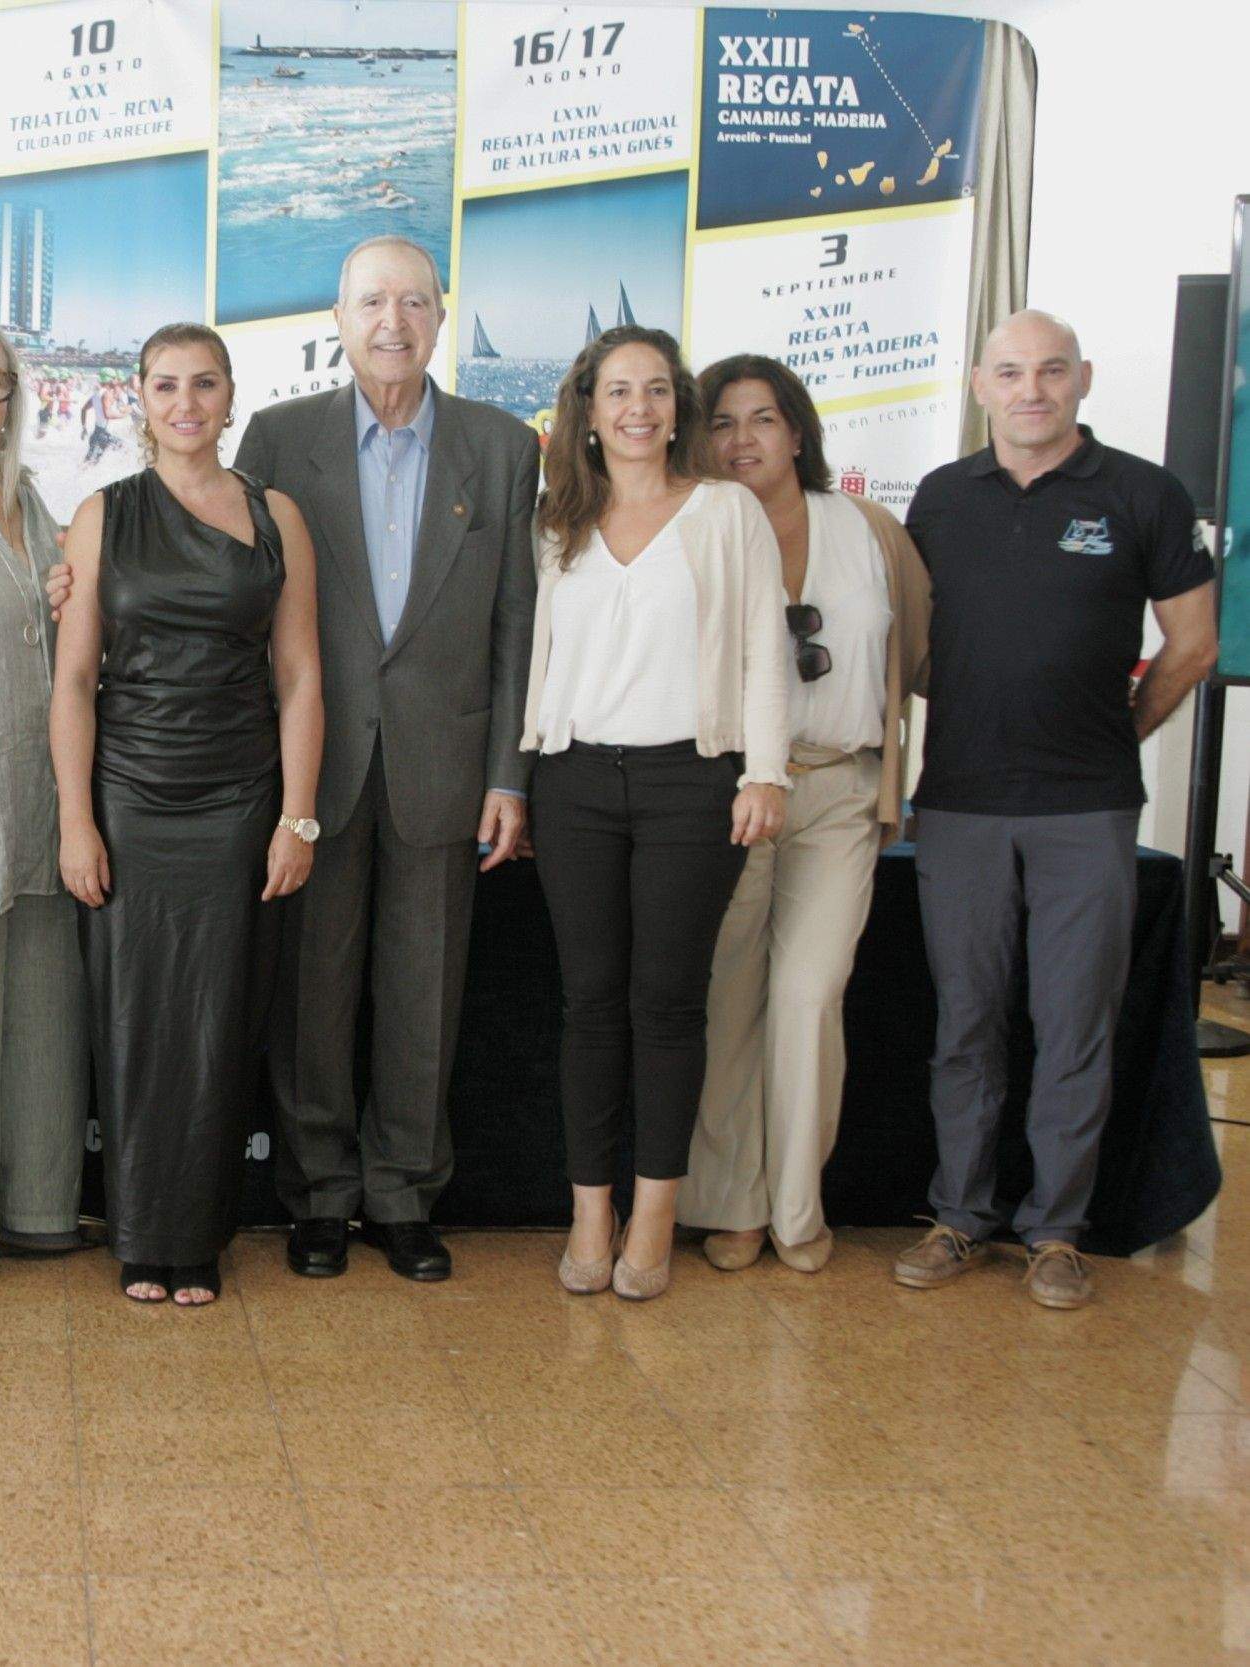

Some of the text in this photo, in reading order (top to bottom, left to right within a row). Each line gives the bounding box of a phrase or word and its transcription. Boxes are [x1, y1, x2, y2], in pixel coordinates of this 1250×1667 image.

[71, 19, 116, 57] 10
[513, 21, 625, 67] 16/17
[718, 36, 810, 67] XXIII
[44, 57, 142, 81] AGOSTO
[525, 63, 622, 86] AGOSTO
[69, 82, 108, 101] XXX
[717, 74, 859, 106] REGATA
[10, 105, 101, 132] TRIATLÓN
[124, 97, 174, 117] RCNA
[553, 104, 600, 123] LXXIV
[717, 110, 801, 126] CANARIAS
[813, 112, 887, 128] MADERIA
[16, 119, 174, 151] CIUDAD DE ARRECIFE
[482, 114, 679, 152] REGATA INTERNACIONAL
[717, 131, 761, 143] Arrecife
[769, 132, 812, 144] Funchal
[492, 135, 673, 171] DE ALTURA SAN GINÉS
[819, 233, 849, 268] 3
[761, 267, 898, 298] SEPTIEMBRE
[802, 302, 852, 322] XXIII
[788, 320, 870, 346] REGATA
[842, 331, 939, 359] MADEIRA
[302, 336, 344, 372] 17
[852, 353, 936, 379] Funchal
